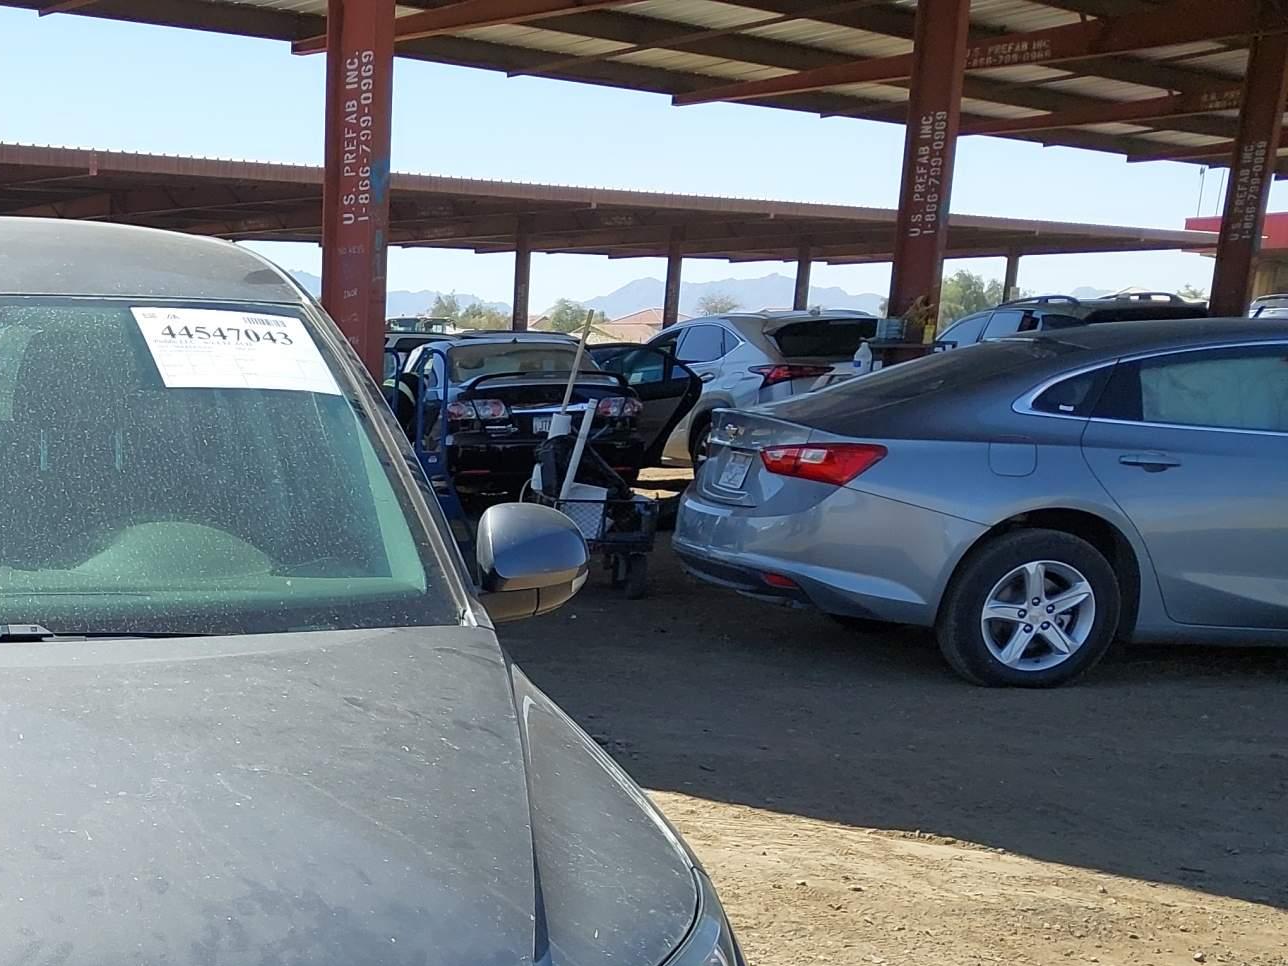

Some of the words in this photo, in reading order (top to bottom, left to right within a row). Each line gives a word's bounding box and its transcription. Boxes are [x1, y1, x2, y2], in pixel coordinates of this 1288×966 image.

[345, 51, 359, 89] INC.
[343, 99, 358, 177] PREFAB
[357, 50, 374, 221] 1-866-799-0969
[919, 111, 934, 139] INC.
[913, 146, 931, 202] PREFAB
[342, 187, 356, 225] U.S.
[908, 209, 924, 237] U.S.
[160, 324, 294, 346] 44547043
